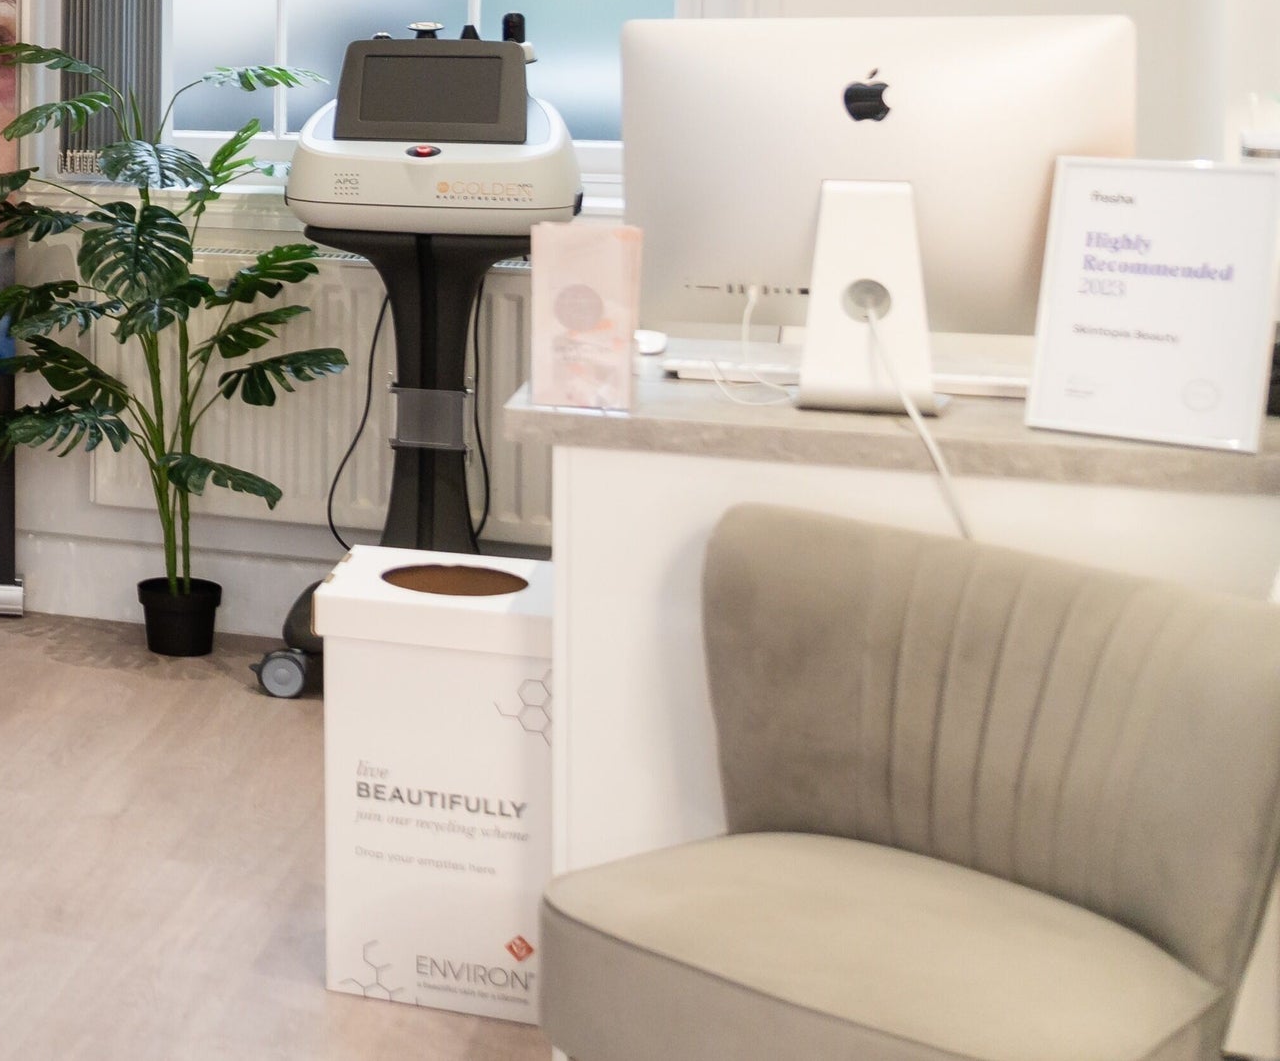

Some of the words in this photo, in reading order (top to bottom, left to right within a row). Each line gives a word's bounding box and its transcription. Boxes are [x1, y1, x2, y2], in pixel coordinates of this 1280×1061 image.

[451, 181, 530, 196] GOLDEN
[1085, 231, 1152, 256] Highly
[1082, 254, 1235, 281] Recommended
[356, 760, 389, 779] live
[355, 780, 529, 819] BEAUTIFULLY
[415, 818, 477, 840] recycling
[354, 845, 384, 860] Drop
[387, 852, 414, 866] your
[416, 857, 467, 873] empties
